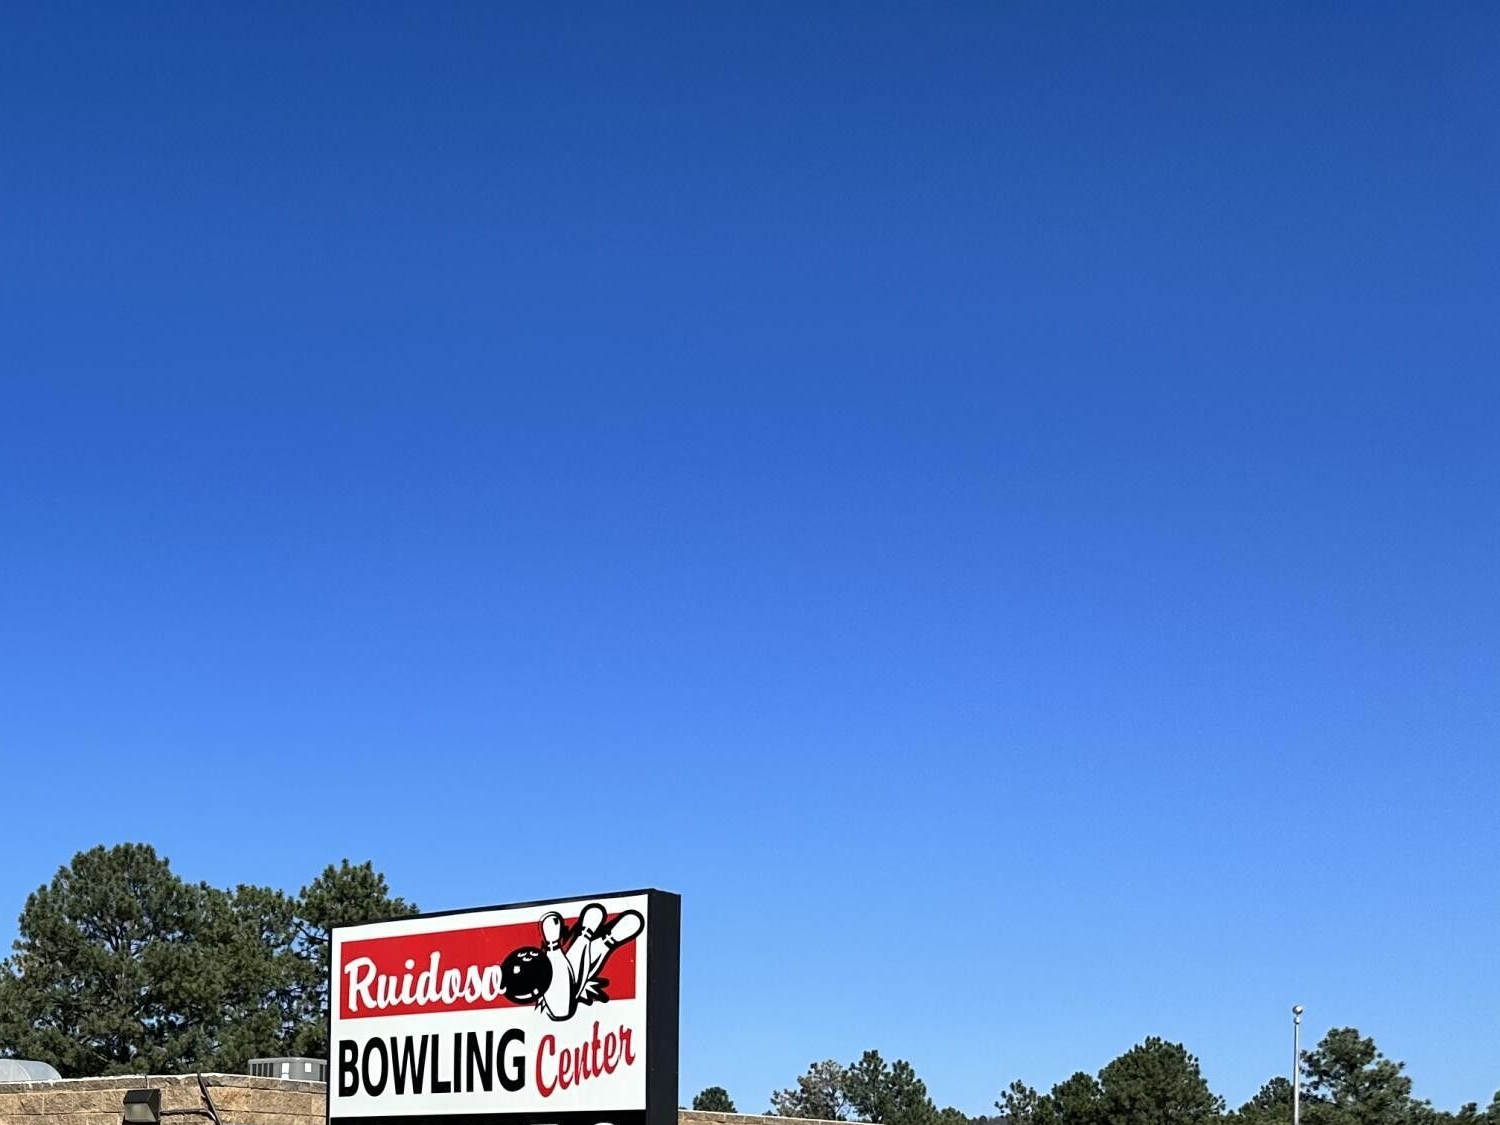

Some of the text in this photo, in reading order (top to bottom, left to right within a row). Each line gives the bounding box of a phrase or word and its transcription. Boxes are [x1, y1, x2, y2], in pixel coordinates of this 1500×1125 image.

[343, 951, 507, 1013] Ruidoso
[338, 1020, 636, 1098] BOWLING Center
